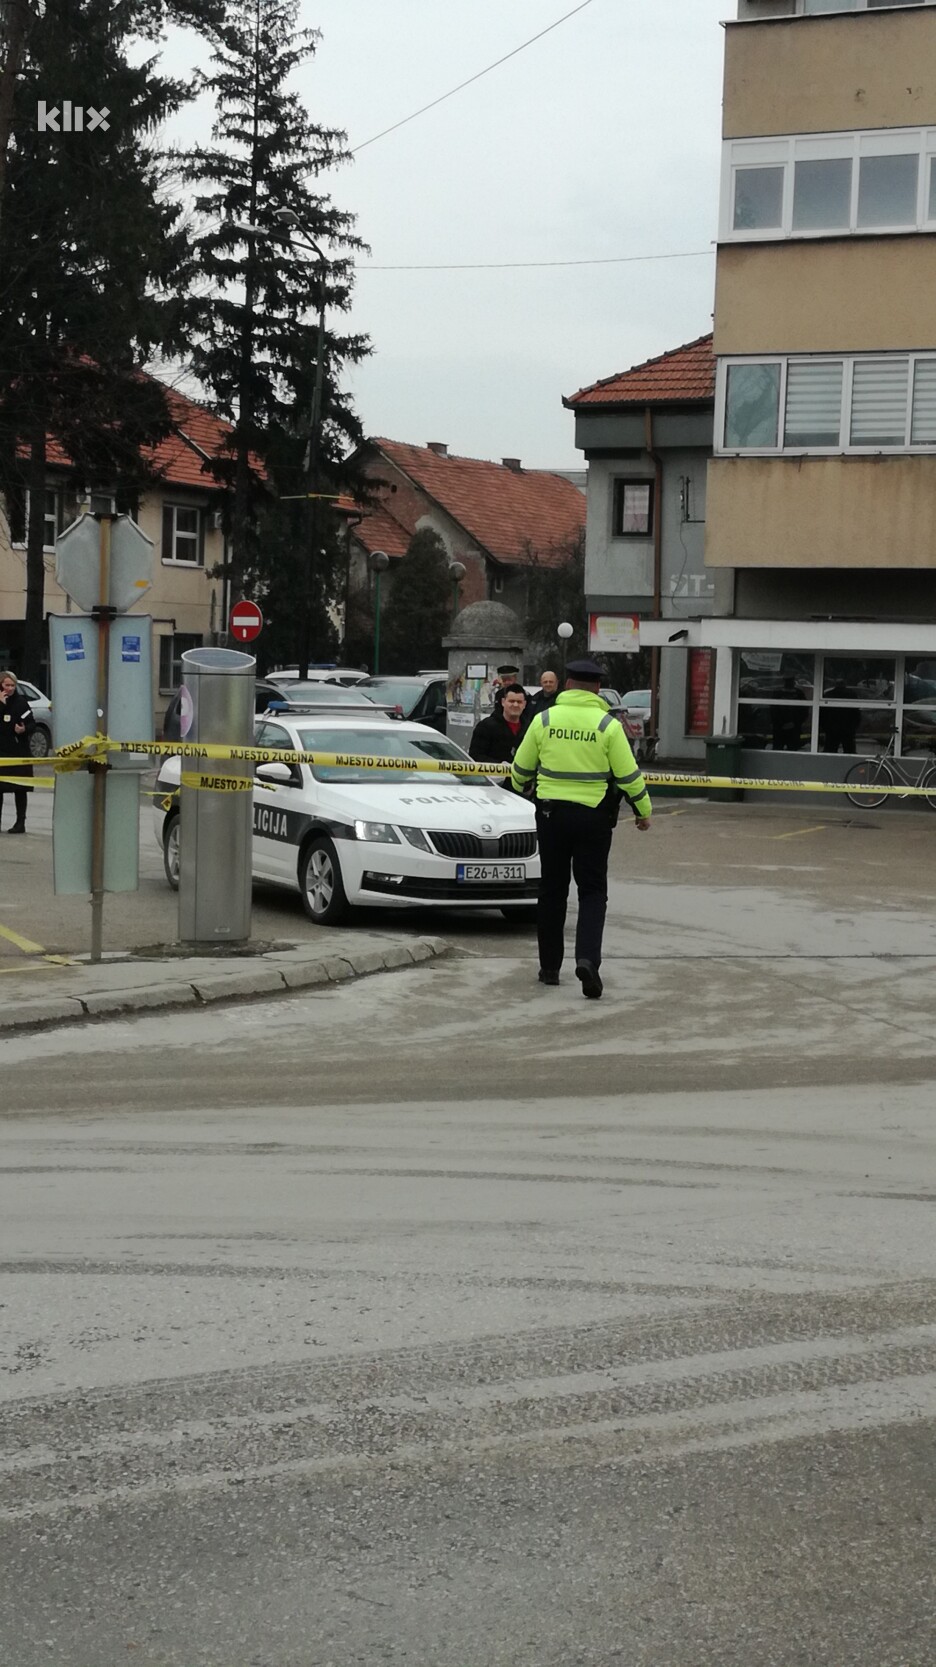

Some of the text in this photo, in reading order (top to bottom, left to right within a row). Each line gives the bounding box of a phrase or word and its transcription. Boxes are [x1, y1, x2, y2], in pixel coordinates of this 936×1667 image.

[549, 728, 597, 742] POLICIJA
[120, 742, 208, 758] MJESTO ZLOČINA
[229, 749, 270, 761] MJESTO
[335, 755, 374, 767] MJESTO
[438, 761, 476, 772] MJESTO
[200, 776, 238, 791] MJESTO
[252, 806, 288, 837] LICIJA
[465, 866, 524, 879] E26-A-311
